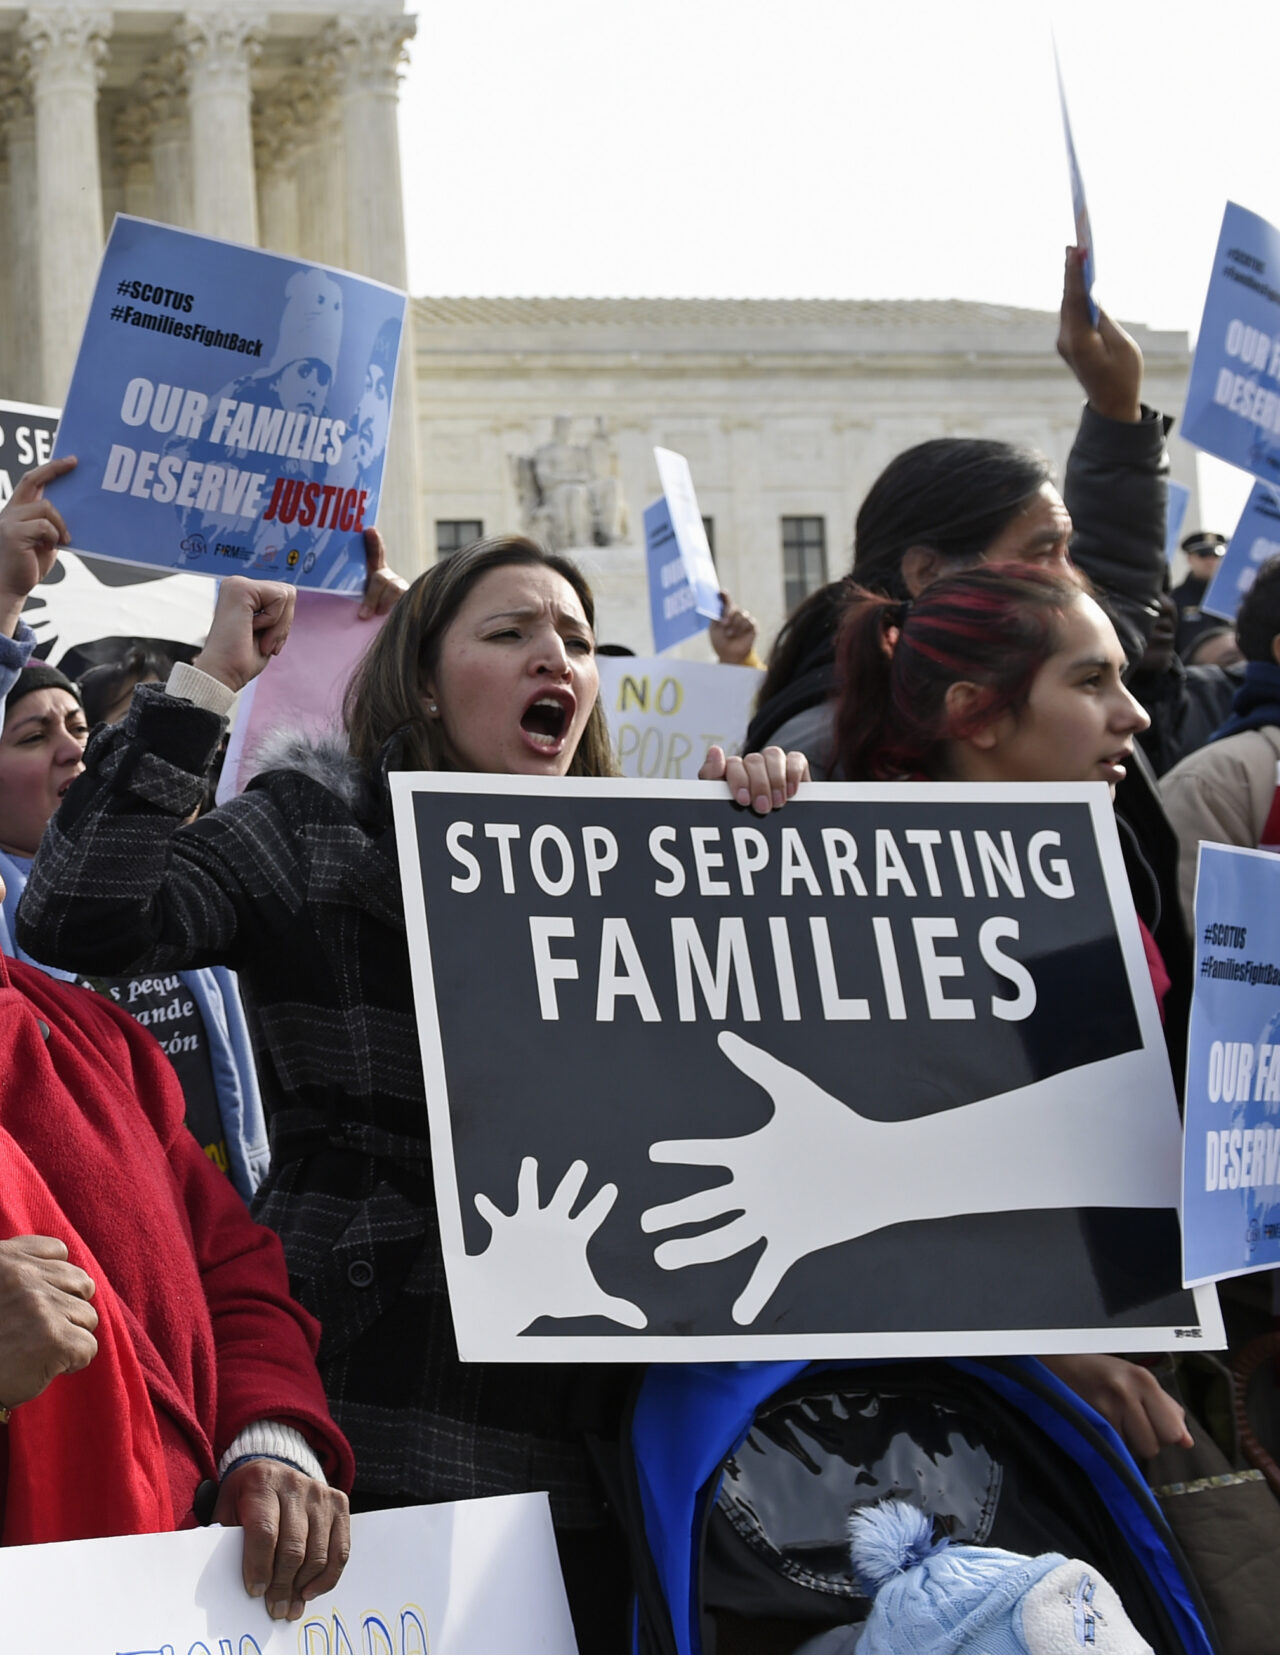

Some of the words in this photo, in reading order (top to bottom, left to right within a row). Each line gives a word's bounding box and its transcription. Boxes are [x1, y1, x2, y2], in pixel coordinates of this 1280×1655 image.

[117, 279, 195, 314] #SCOTUS
[110, 304, 264, 358] #FamiliesFightBack
[1225, 318, 1270, 372] OUR
[120, 377, 209, 440] OUR
[210, 397, 346, 466] FAMILIES
[101, 444, 267, 520] DESERVE
[263, 477, 368, 533] JUSTICE
[617, 674, 684, 716] NO
[445, 820, 619, 898] STOP
[648, 824, 1077, 901] SEPARATING
[1204, 923, 1247, 949] #SCOTUS
[528, 915, 1037, 1023] FAMILIES
[132, 998, 193, 1026] ande
[1208, 1040, 1254, 1103] OUR
